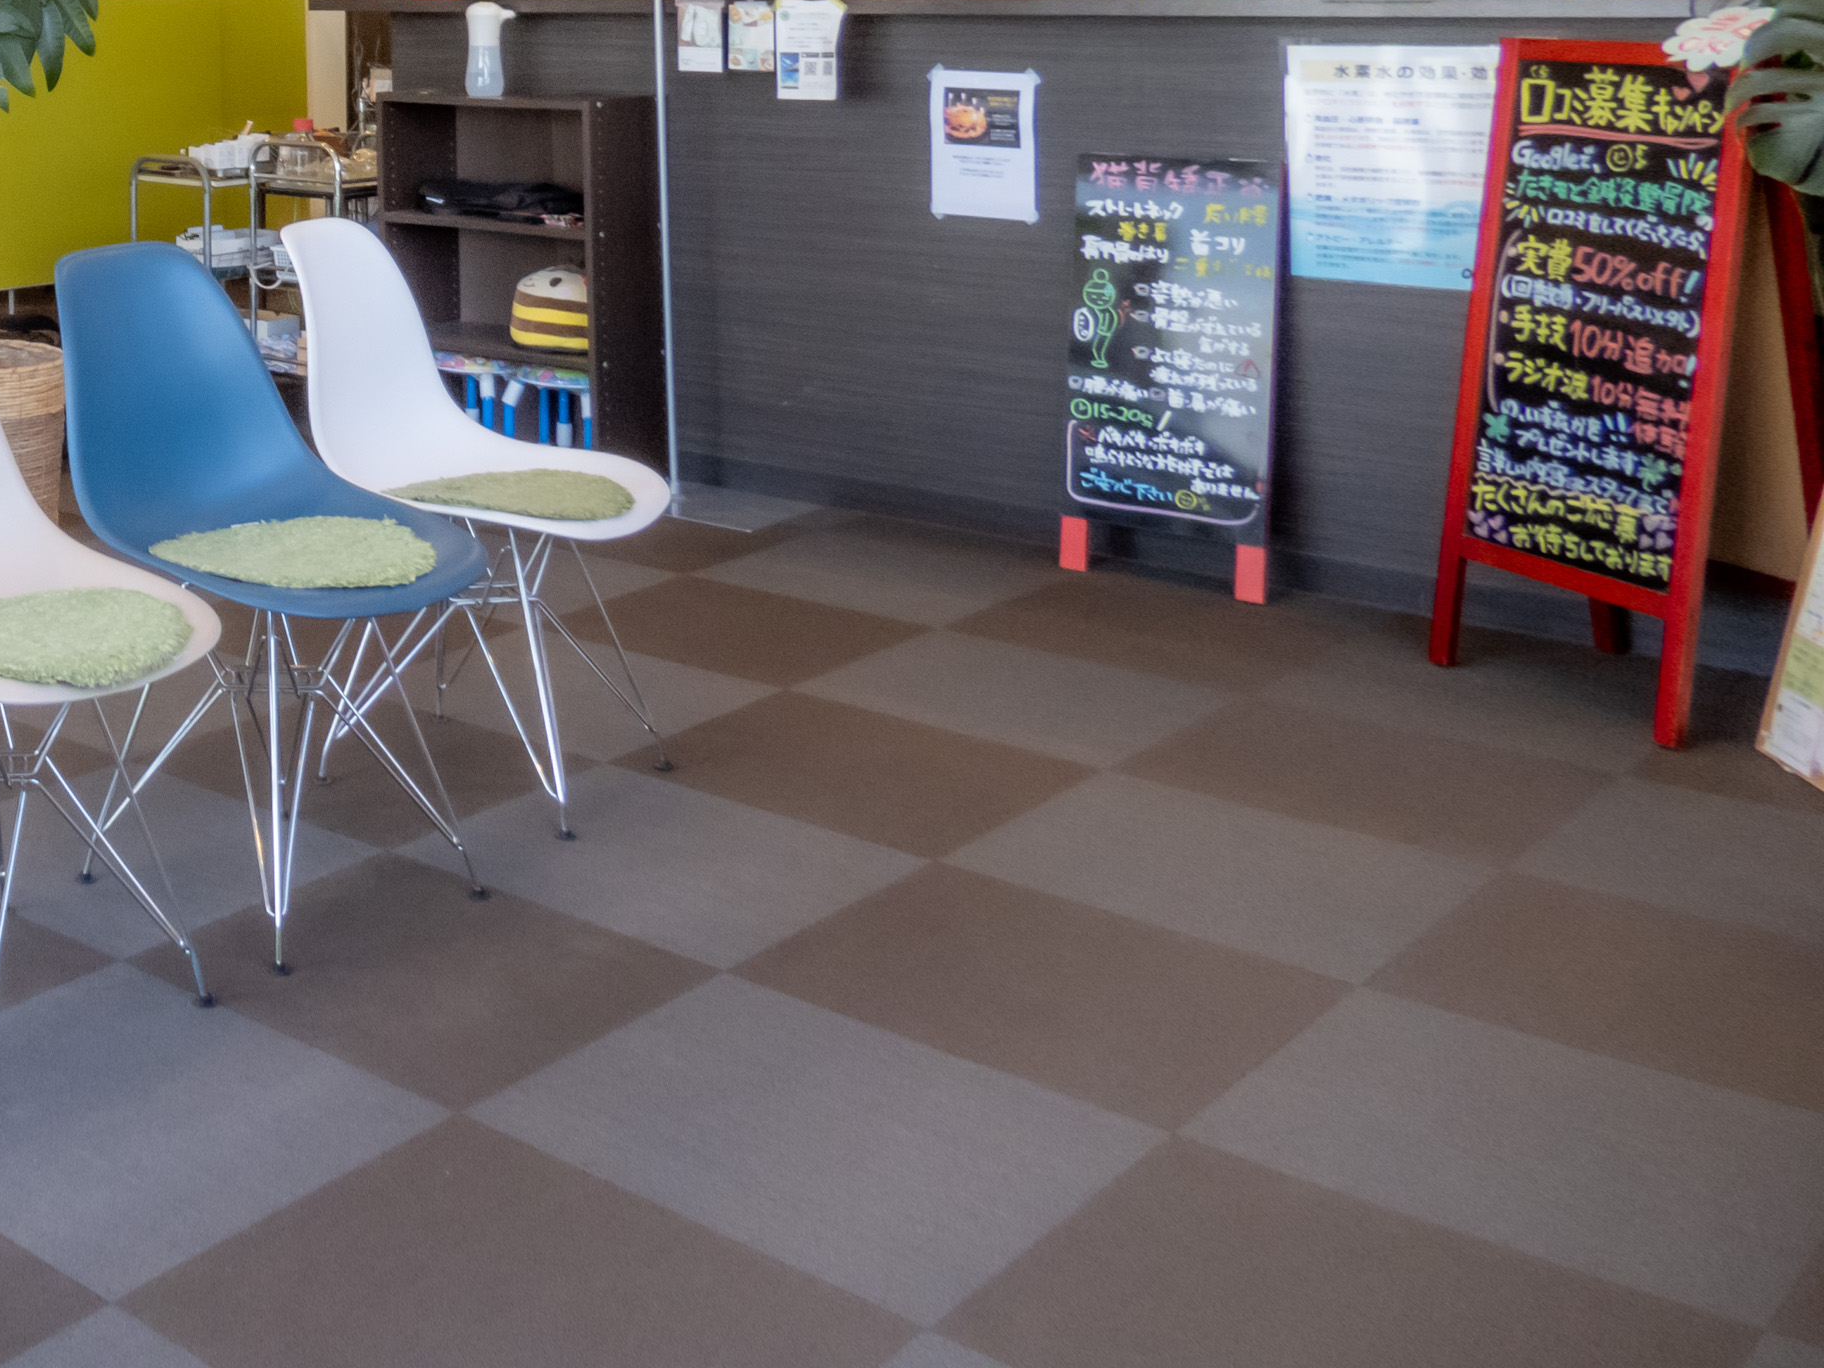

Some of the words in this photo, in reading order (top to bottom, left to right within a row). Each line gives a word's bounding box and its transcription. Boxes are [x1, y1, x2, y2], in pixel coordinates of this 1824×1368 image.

[1519, 64, 1725, 134] 口コミ募集キャンペーン
[1085, 198, 1185, 221] ストレートネック
[1516, 234, 1573, 282] 実費
